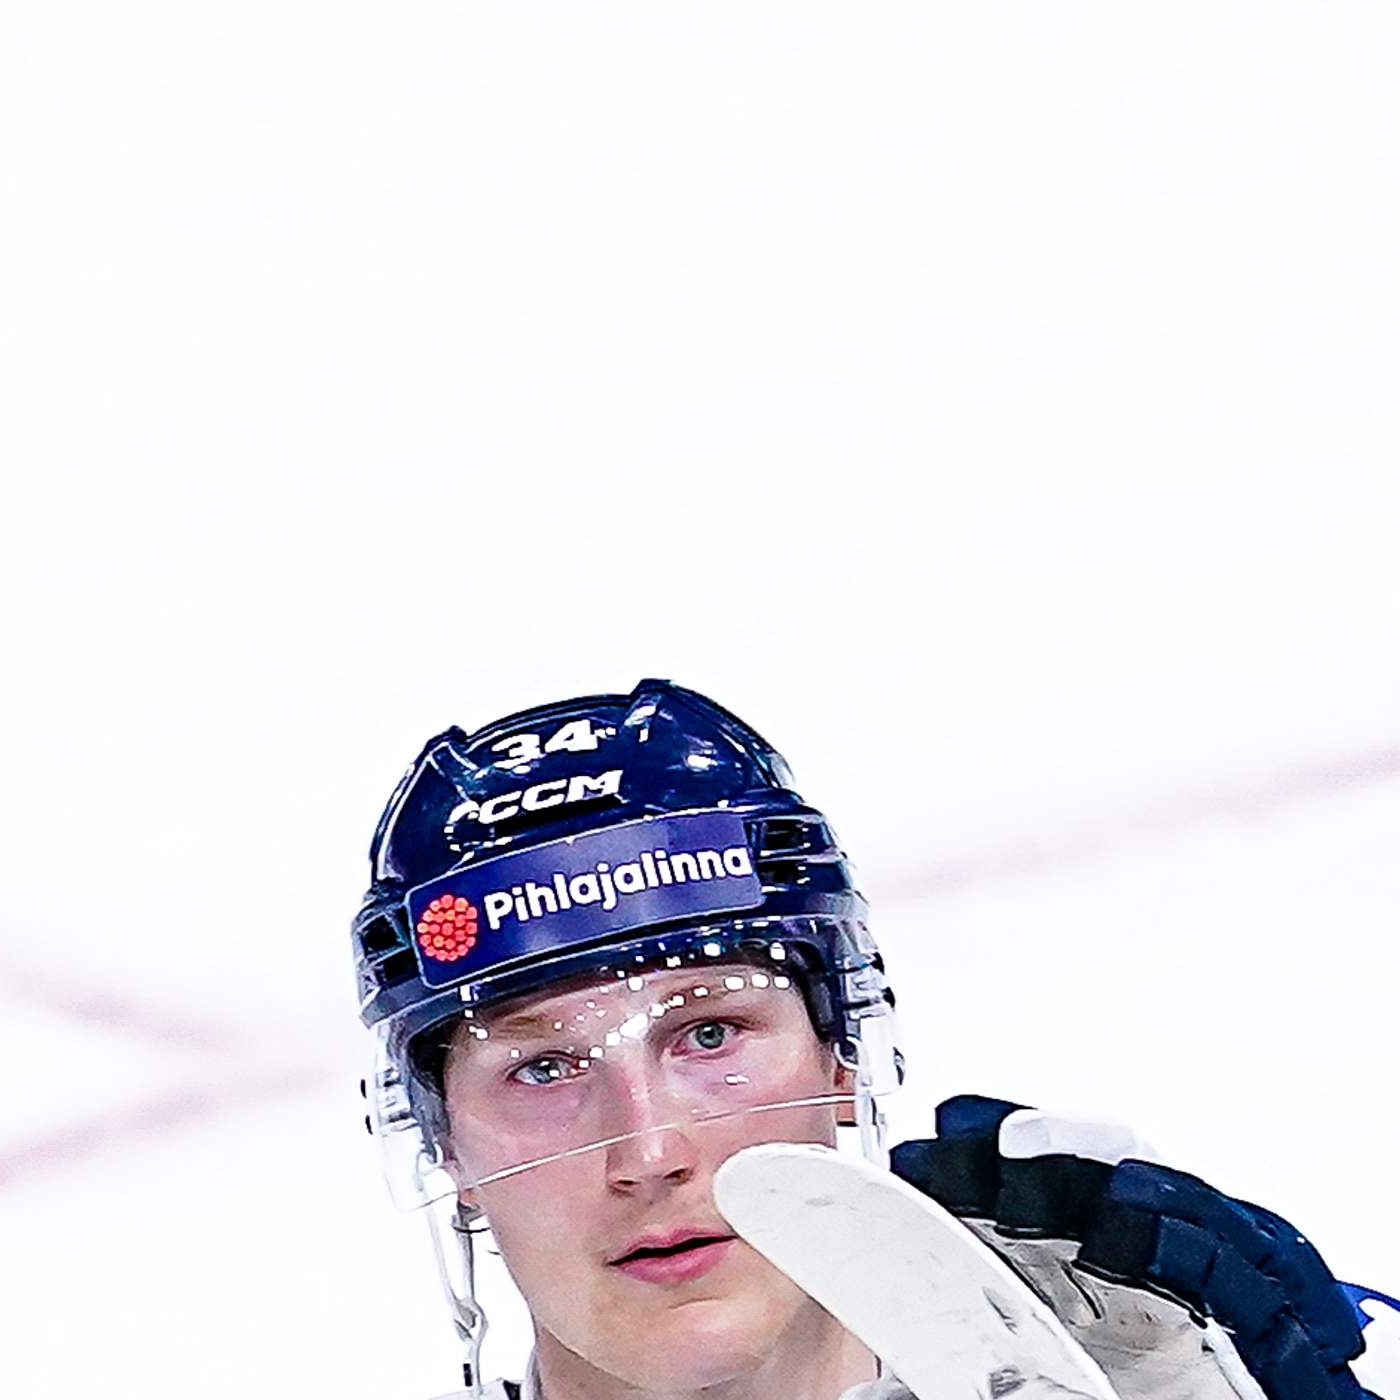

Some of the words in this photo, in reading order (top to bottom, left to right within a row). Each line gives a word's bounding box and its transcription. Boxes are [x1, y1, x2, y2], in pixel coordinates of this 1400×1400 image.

[490, 719, 599, 768] 34
[477, 769, 624, 824] CCM
[484, 847, 753, 930] Pihlajalinna
